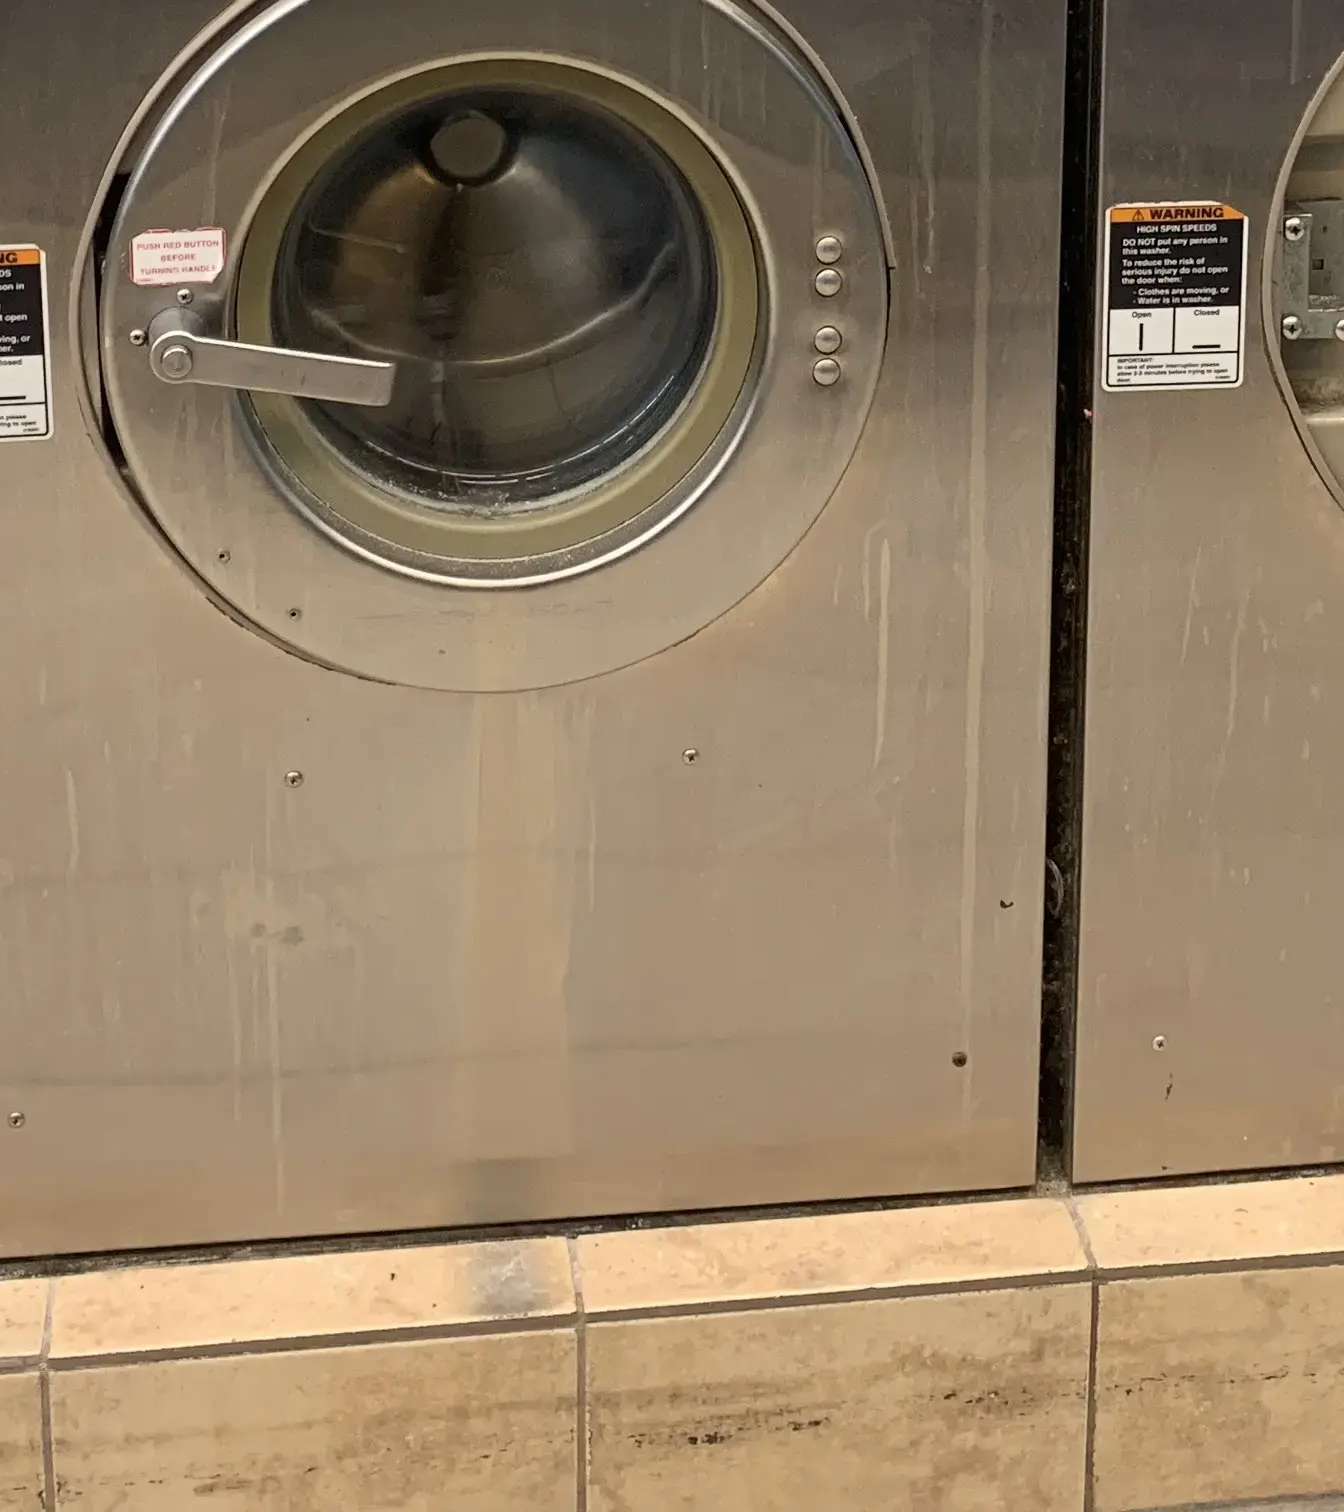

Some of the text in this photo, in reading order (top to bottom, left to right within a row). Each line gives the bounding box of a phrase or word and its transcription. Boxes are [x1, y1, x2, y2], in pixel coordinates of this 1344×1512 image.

[1149, 208, 1224, 220] WARNING
[1137, 224, 1217, 234] HIGH SPIN SPEEDS
[1157, 238, 1171, 246] put
[1173, 238, 1188, 246] any
[1189, 237, 1218, 245] person
[1154, 268, 1177, 276] injury
[1138, 288, 1170, 296] Clothes
